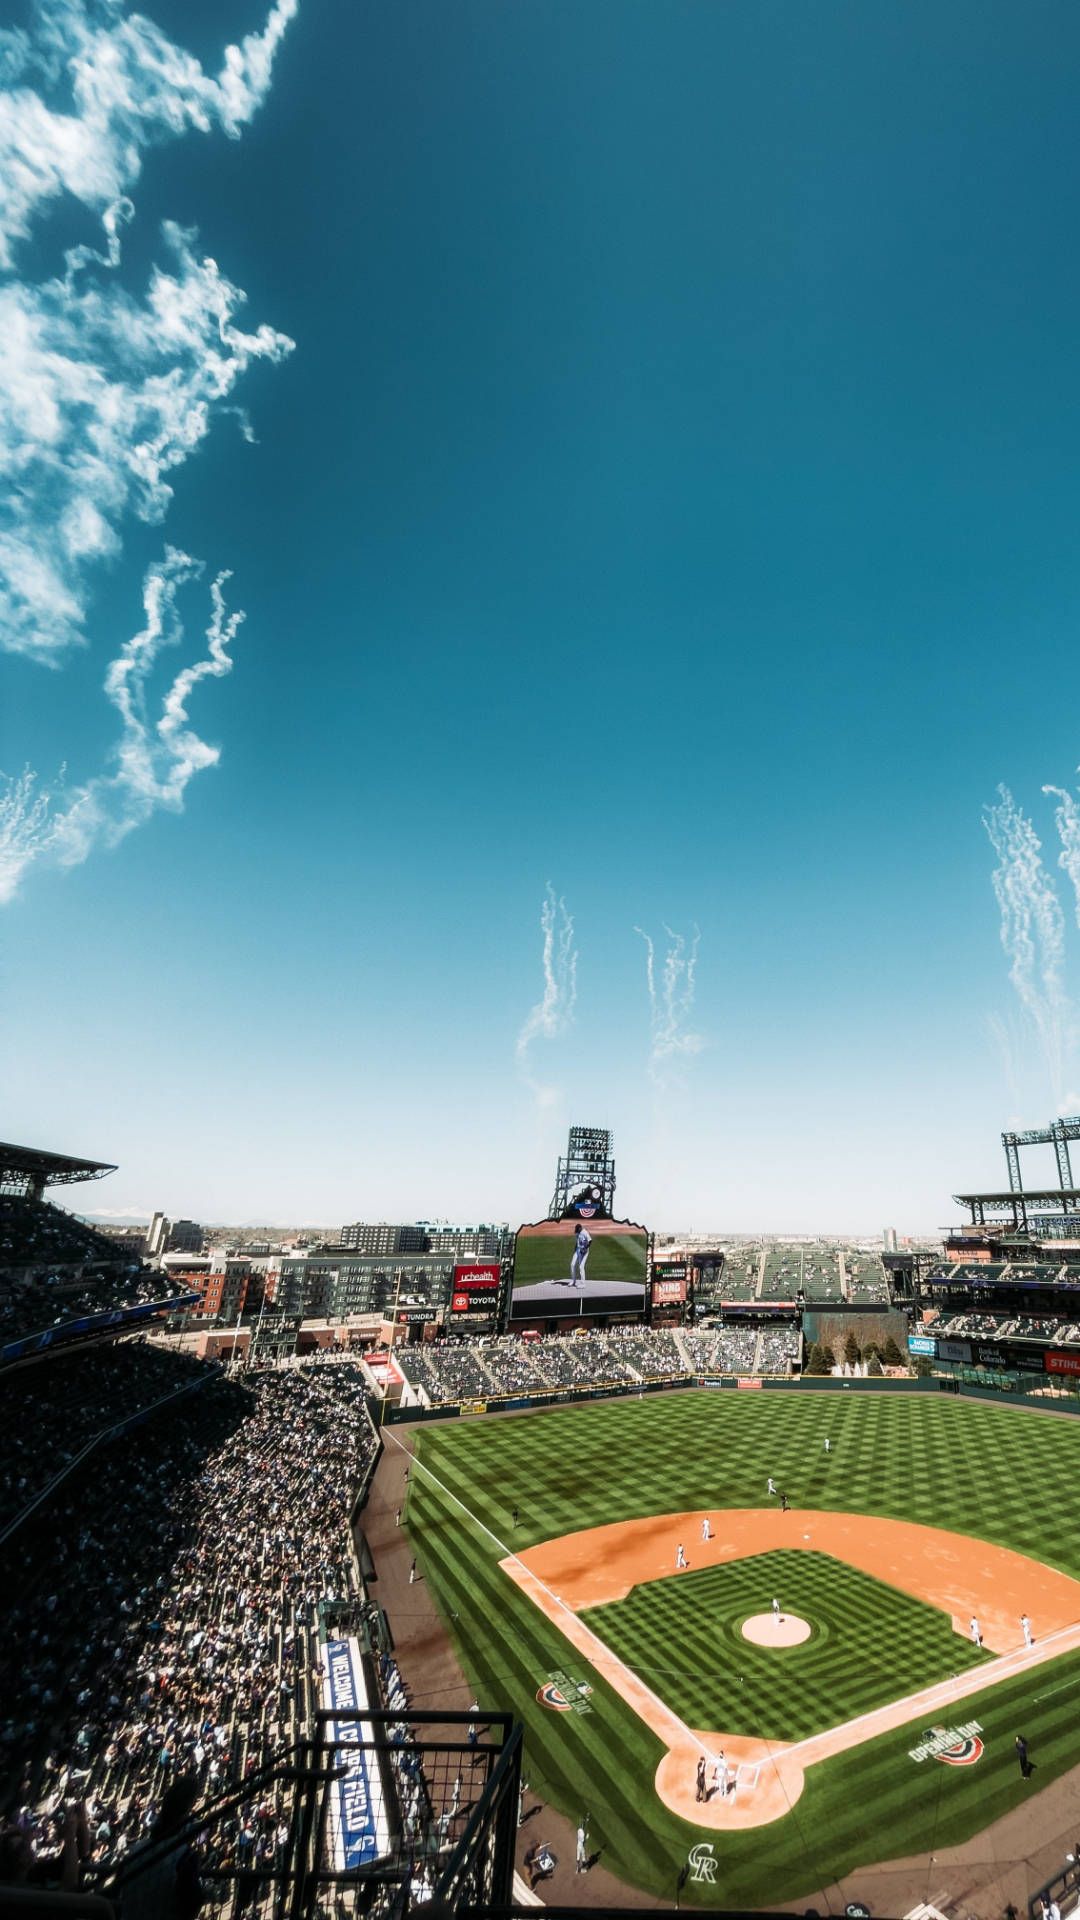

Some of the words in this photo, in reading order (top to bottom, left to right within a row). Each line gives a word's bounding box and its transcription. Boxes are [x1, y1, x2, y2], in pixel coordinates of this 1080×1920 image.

[461, 1271, 494, 1281] uchealth
[469, 1296, 497, 1305] TOYOTA
[407, 1313, 434, 1321] TUNDRA
[979, 1354, 1006, 1364] Colorado
[332, 1654, 355, 1710] WELCOME
[908, 1731, 963, 1762] OPENING
[957, 1720, 984, 1738] DAY
[343, 1779, 370, 1831] FIELD
